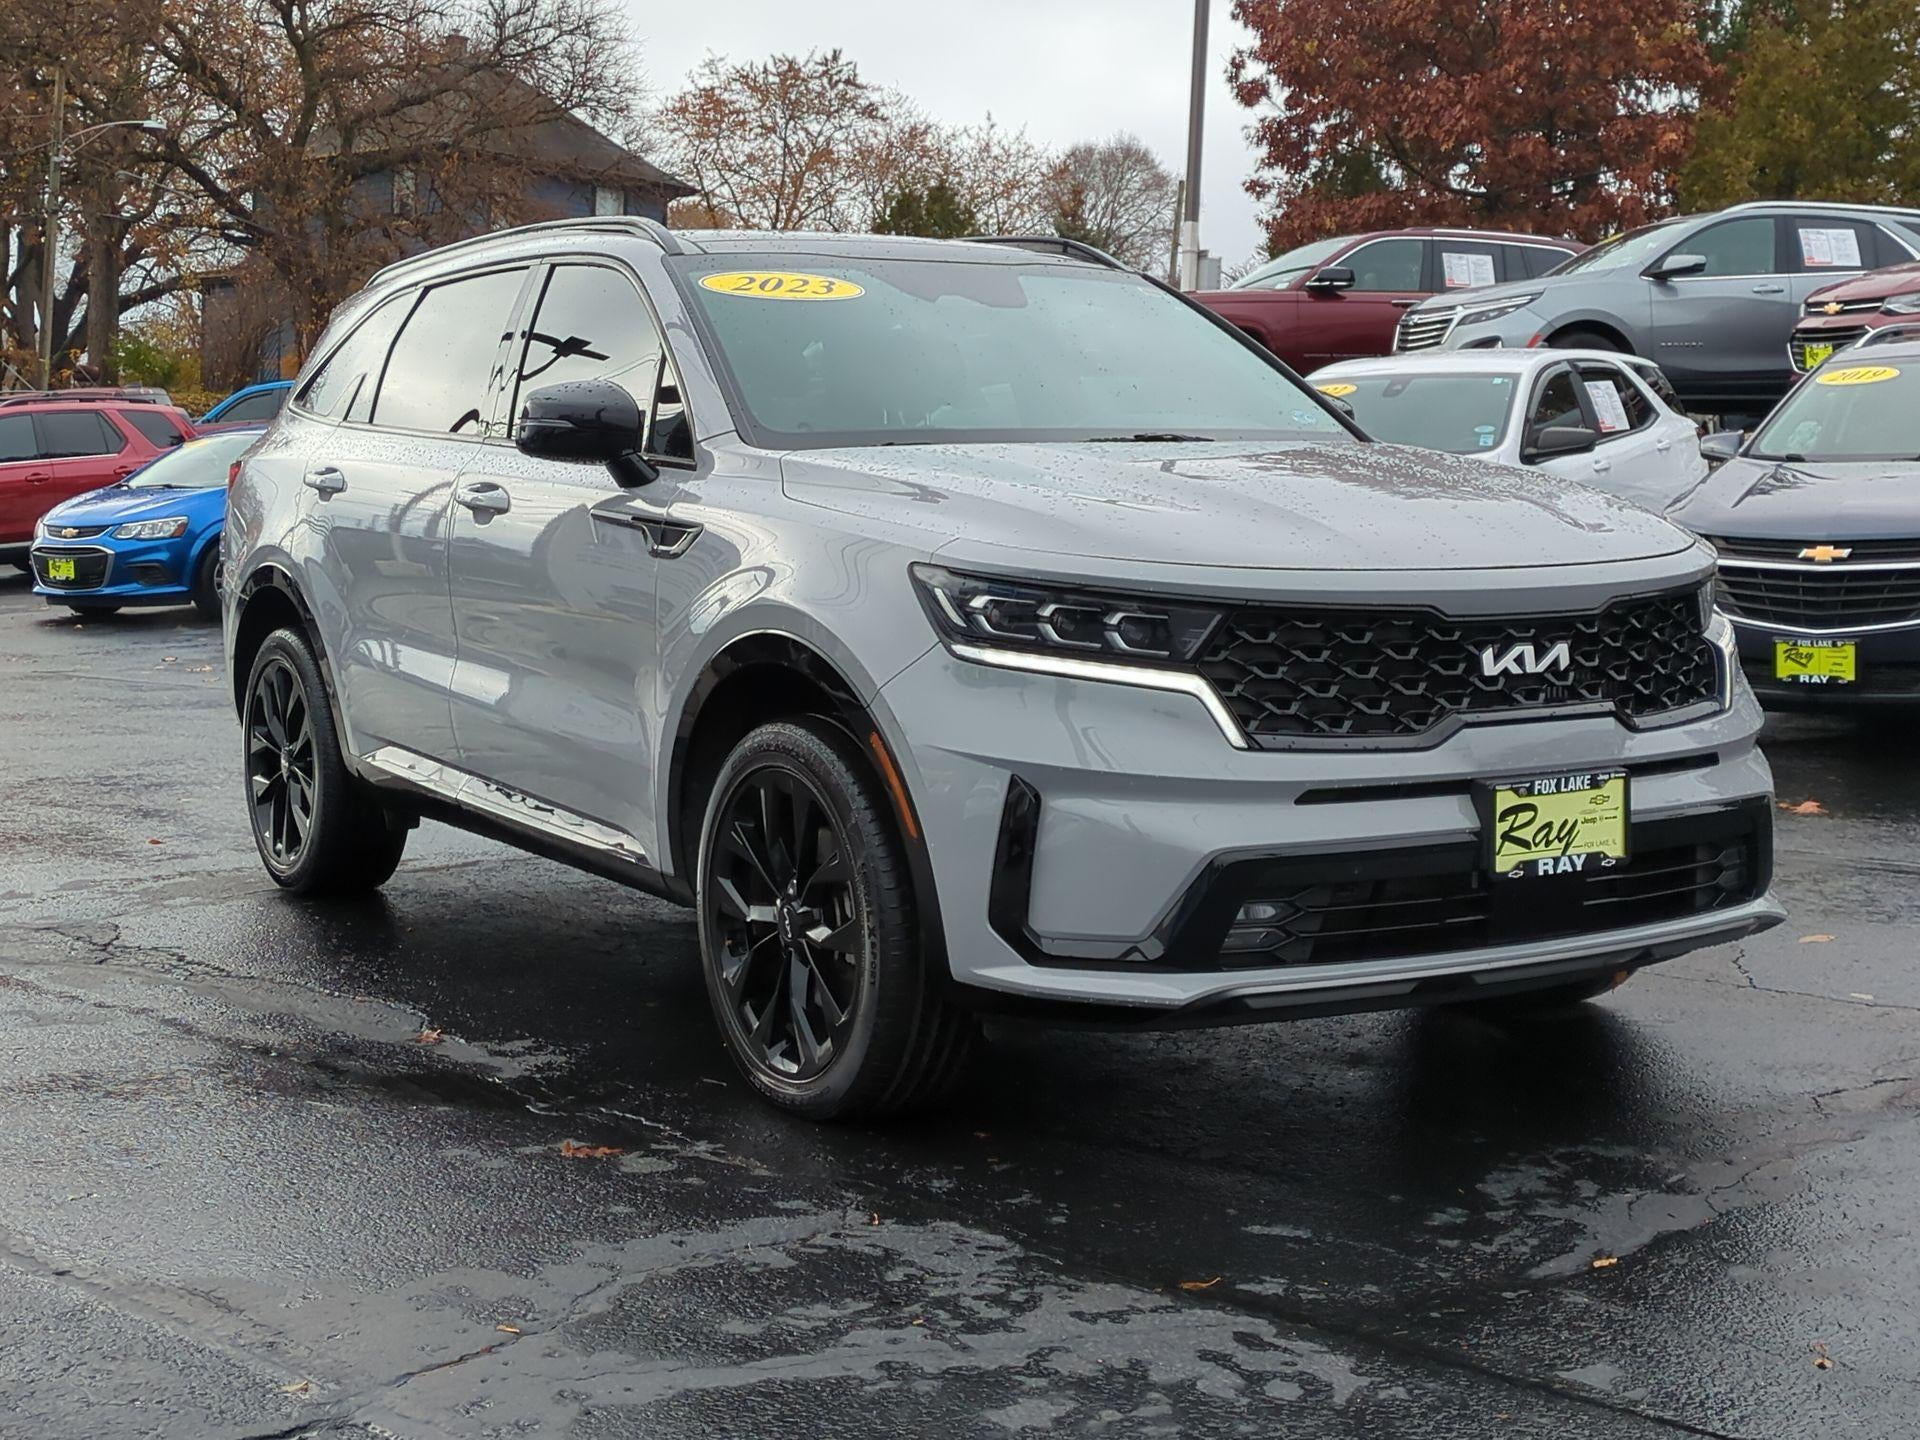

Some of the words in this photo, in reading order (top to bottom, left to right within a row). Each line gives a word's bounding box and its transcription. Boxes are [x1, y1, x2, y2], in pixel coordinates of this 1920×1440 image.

[731, 276, 837, 295] 2023
[1827, 369, 1888, 382] 2019
[1797, 639, 1812, 647] FOX
[1813, 639, 1832, 648] LAKE
[1480, 641, 1571, 677] KIA
[1800, 674, 1830, 684] RAY
[1534, 778, 1557, 795] FOX
[1560, 775, 1592, 793] LAKE
[1496, 802, 1581, 857] Ray
[1538, 853, 1588, 876] RAY
